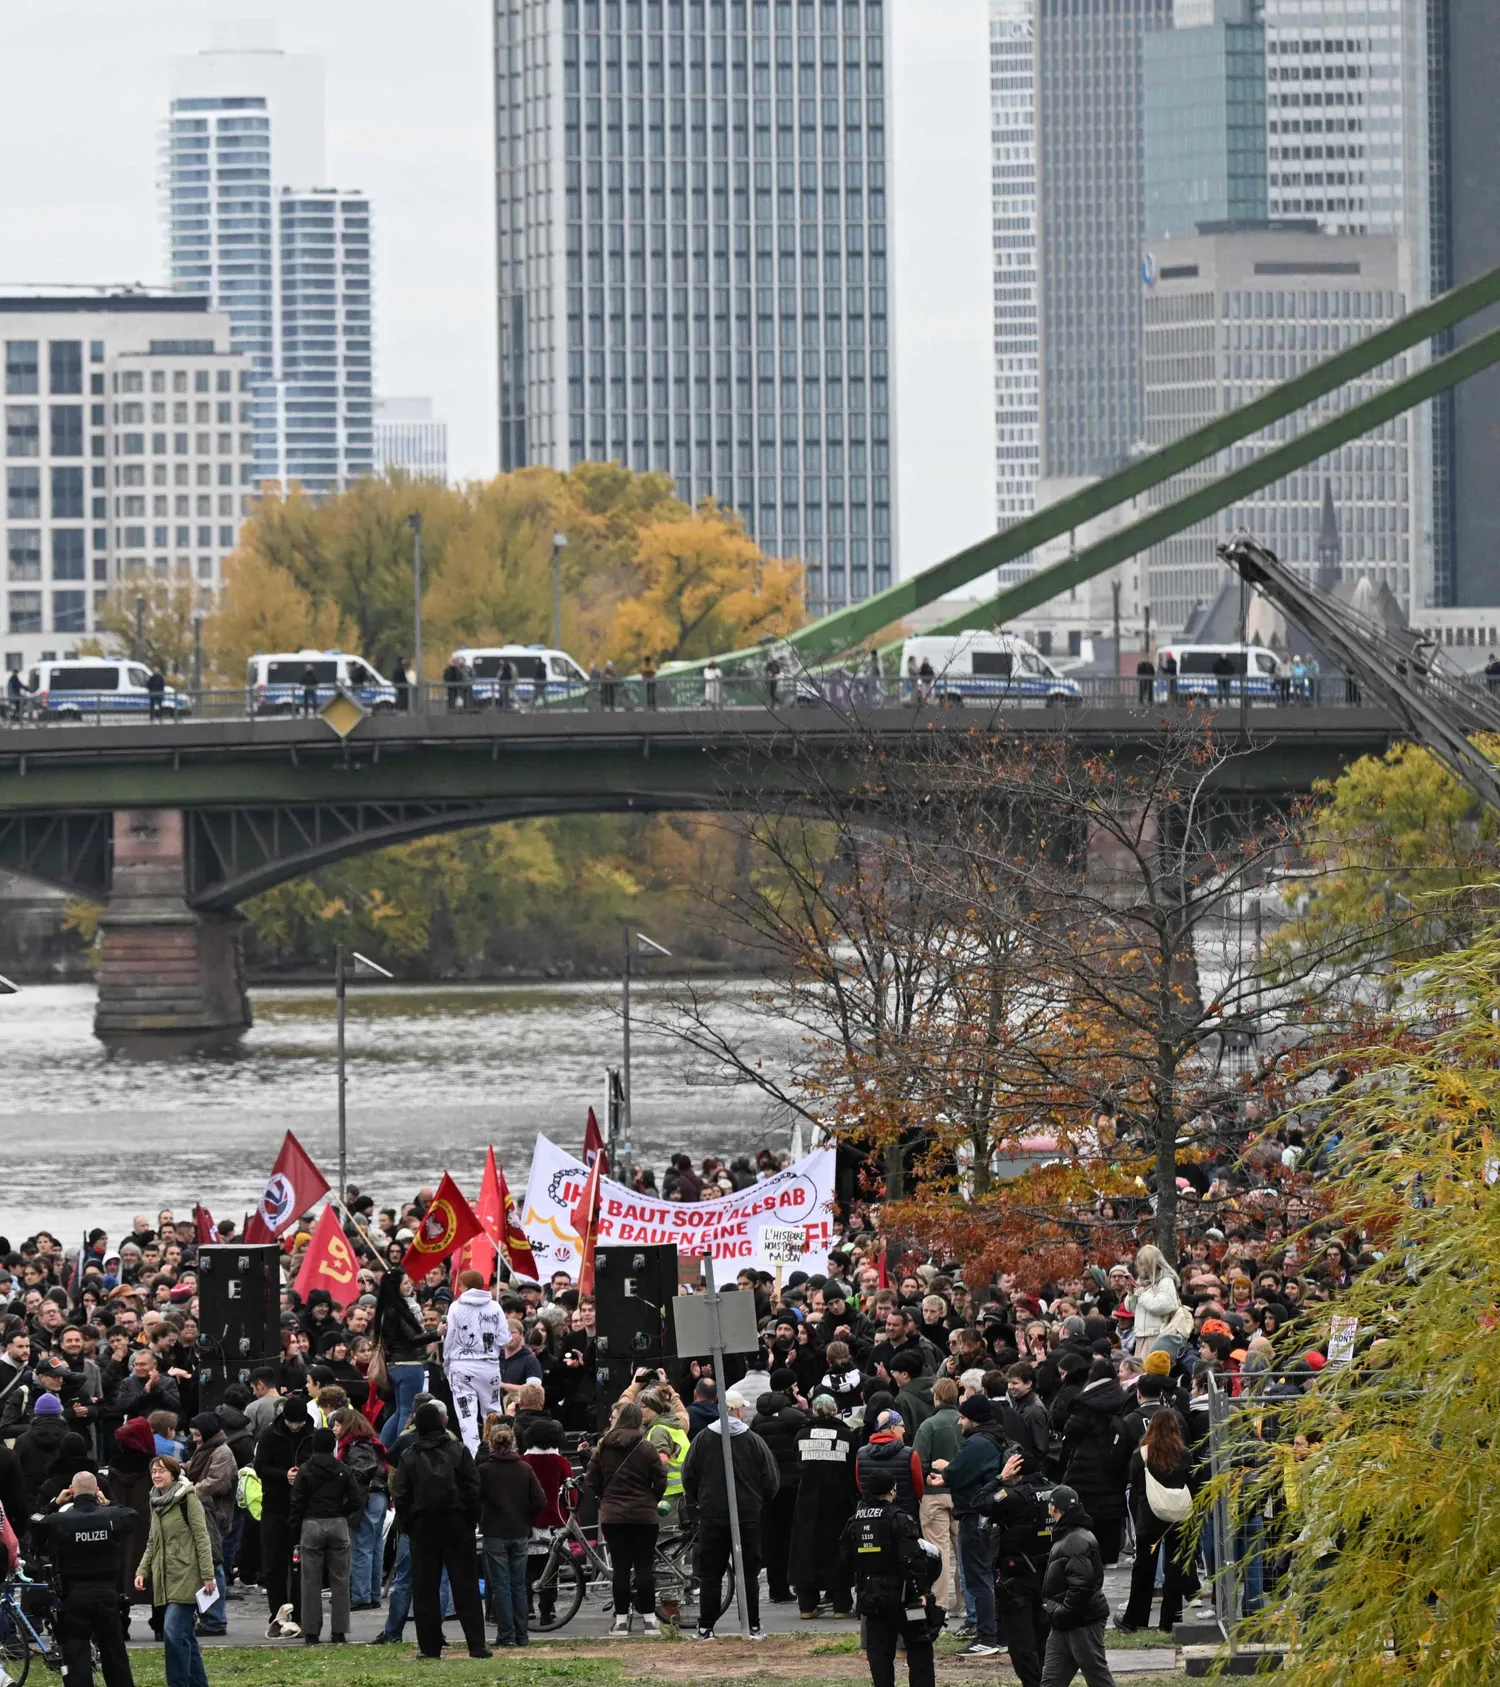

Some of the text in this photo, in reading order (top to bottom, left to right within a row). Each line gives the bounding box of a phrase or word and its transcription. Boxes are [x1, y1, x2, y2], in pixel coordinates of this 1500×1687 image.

[608, 1200, 669, 1224] BAUT
[672, 1196, 777, 1227] SOZIALES
[779, 1187, 806, 1208] AB
[618, 1222, 748, 1245] BAUEN EINE
[769, 1252, 801, 1263] RAISON
[855, 1508, 883, 1519] POLIZEI
[75, 1530, 108, 1542] POLIZEI
